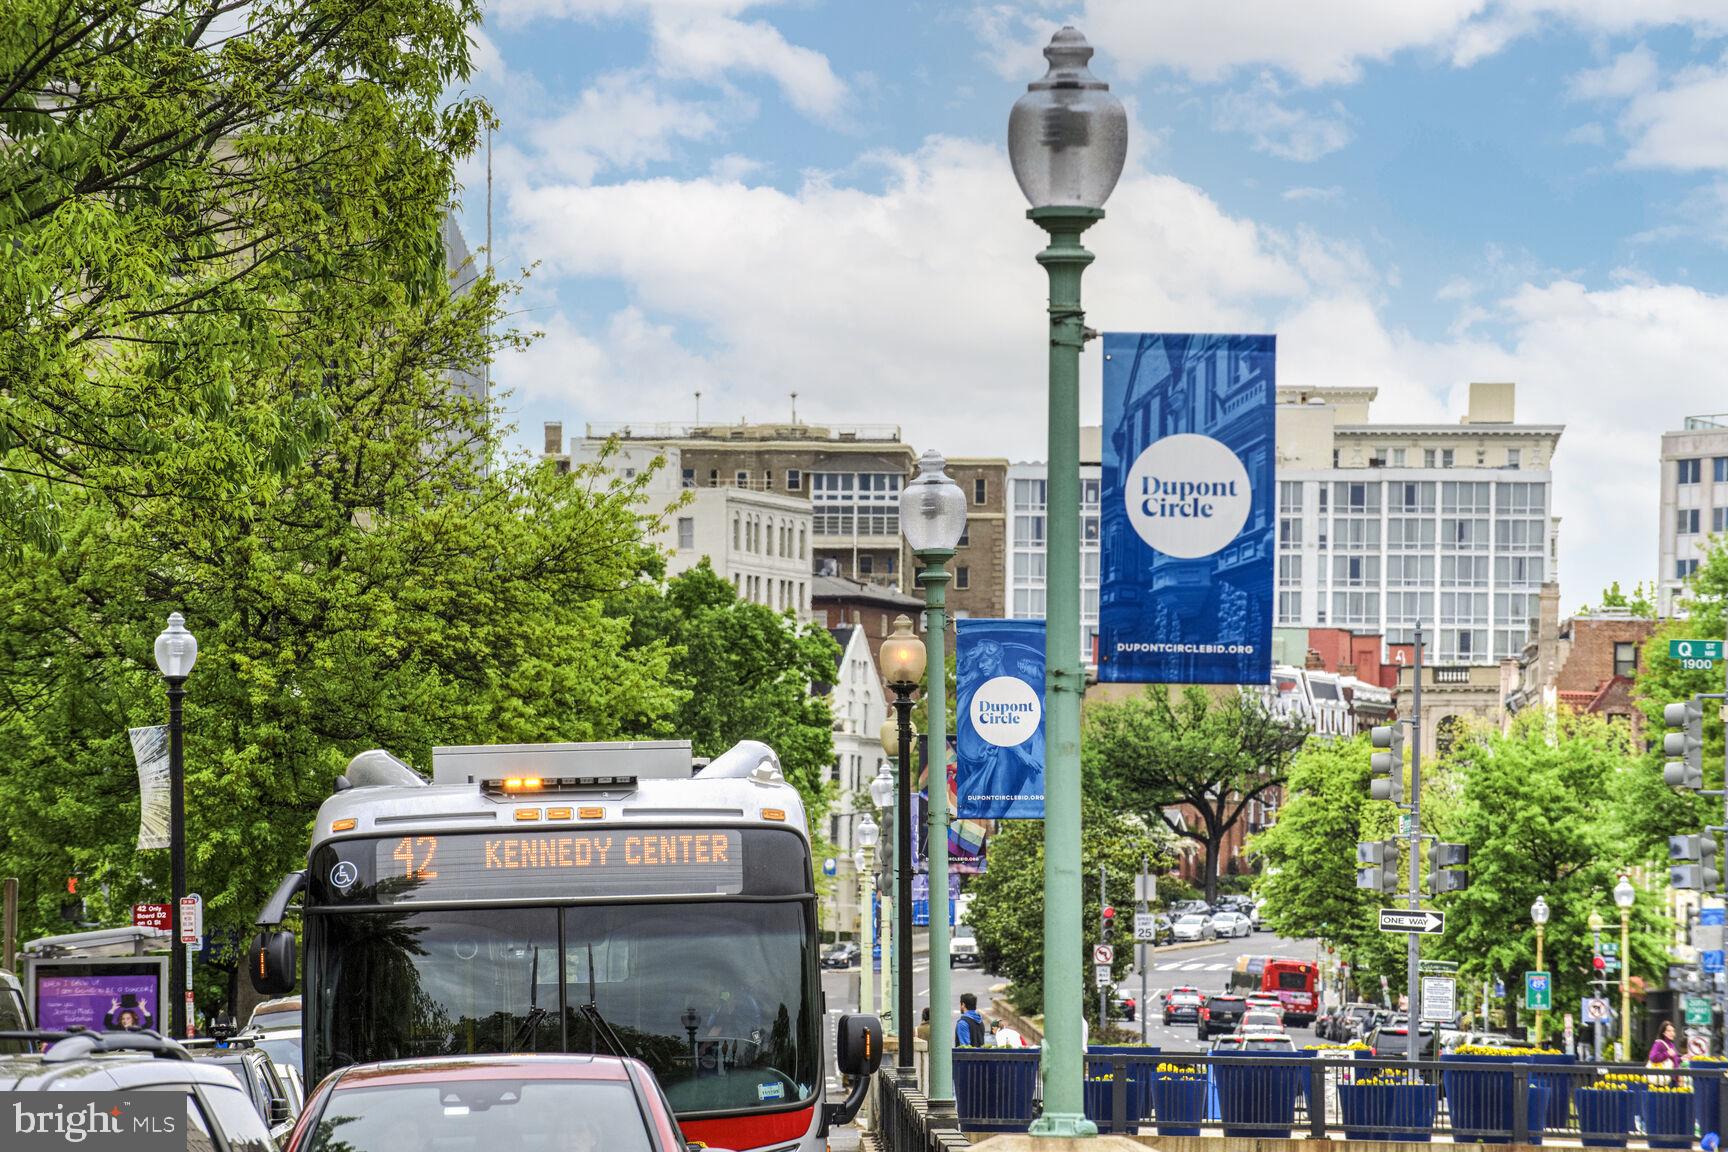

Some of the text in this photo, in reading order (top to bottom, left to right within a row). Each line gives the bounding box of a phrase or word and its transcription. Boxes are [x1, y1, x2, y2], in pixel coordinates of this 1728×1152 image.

[1141, 476, 1238, 497] Dupont
[1141, 497, 1214, 518] Circle
[1116, 643, 1254, 654] DUPONTCIRCLEBID.ORG
[1678, 642, 1692, 657] Q
[1682, 659, 1712, 669] 1900
[979, 701, 1034, 715] Dupont
[979, 711, 1021, 725] Circle
[393, 835, 729, 879] 42 KENNEDY CENTER
[1383, 917, 1429, 926] ONE WAY
[1138, 929, 1152, 938] 25
